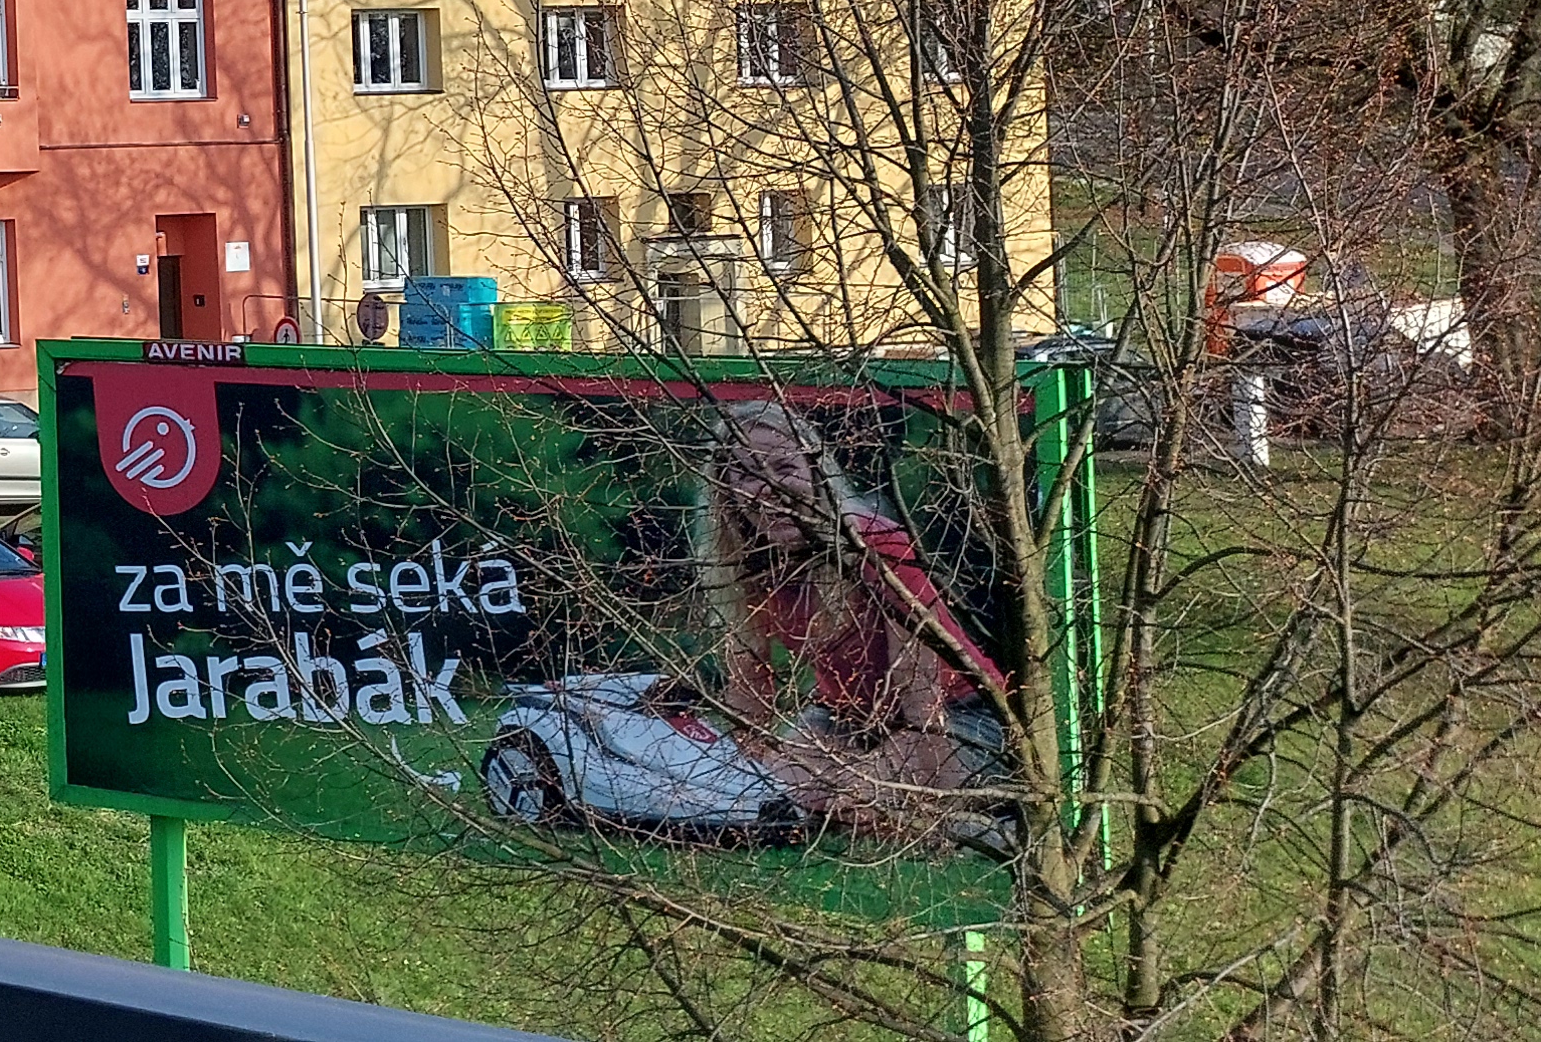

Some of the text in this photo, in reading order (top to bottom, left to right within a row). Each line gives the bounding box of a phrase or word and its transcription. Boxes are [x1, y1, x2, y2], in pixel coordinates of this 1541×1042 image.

[148, 342, 242, 361] AVENIR
[115, 539, 527, 614] za mě seká
[128, 628, 468, 725] Jarabák
